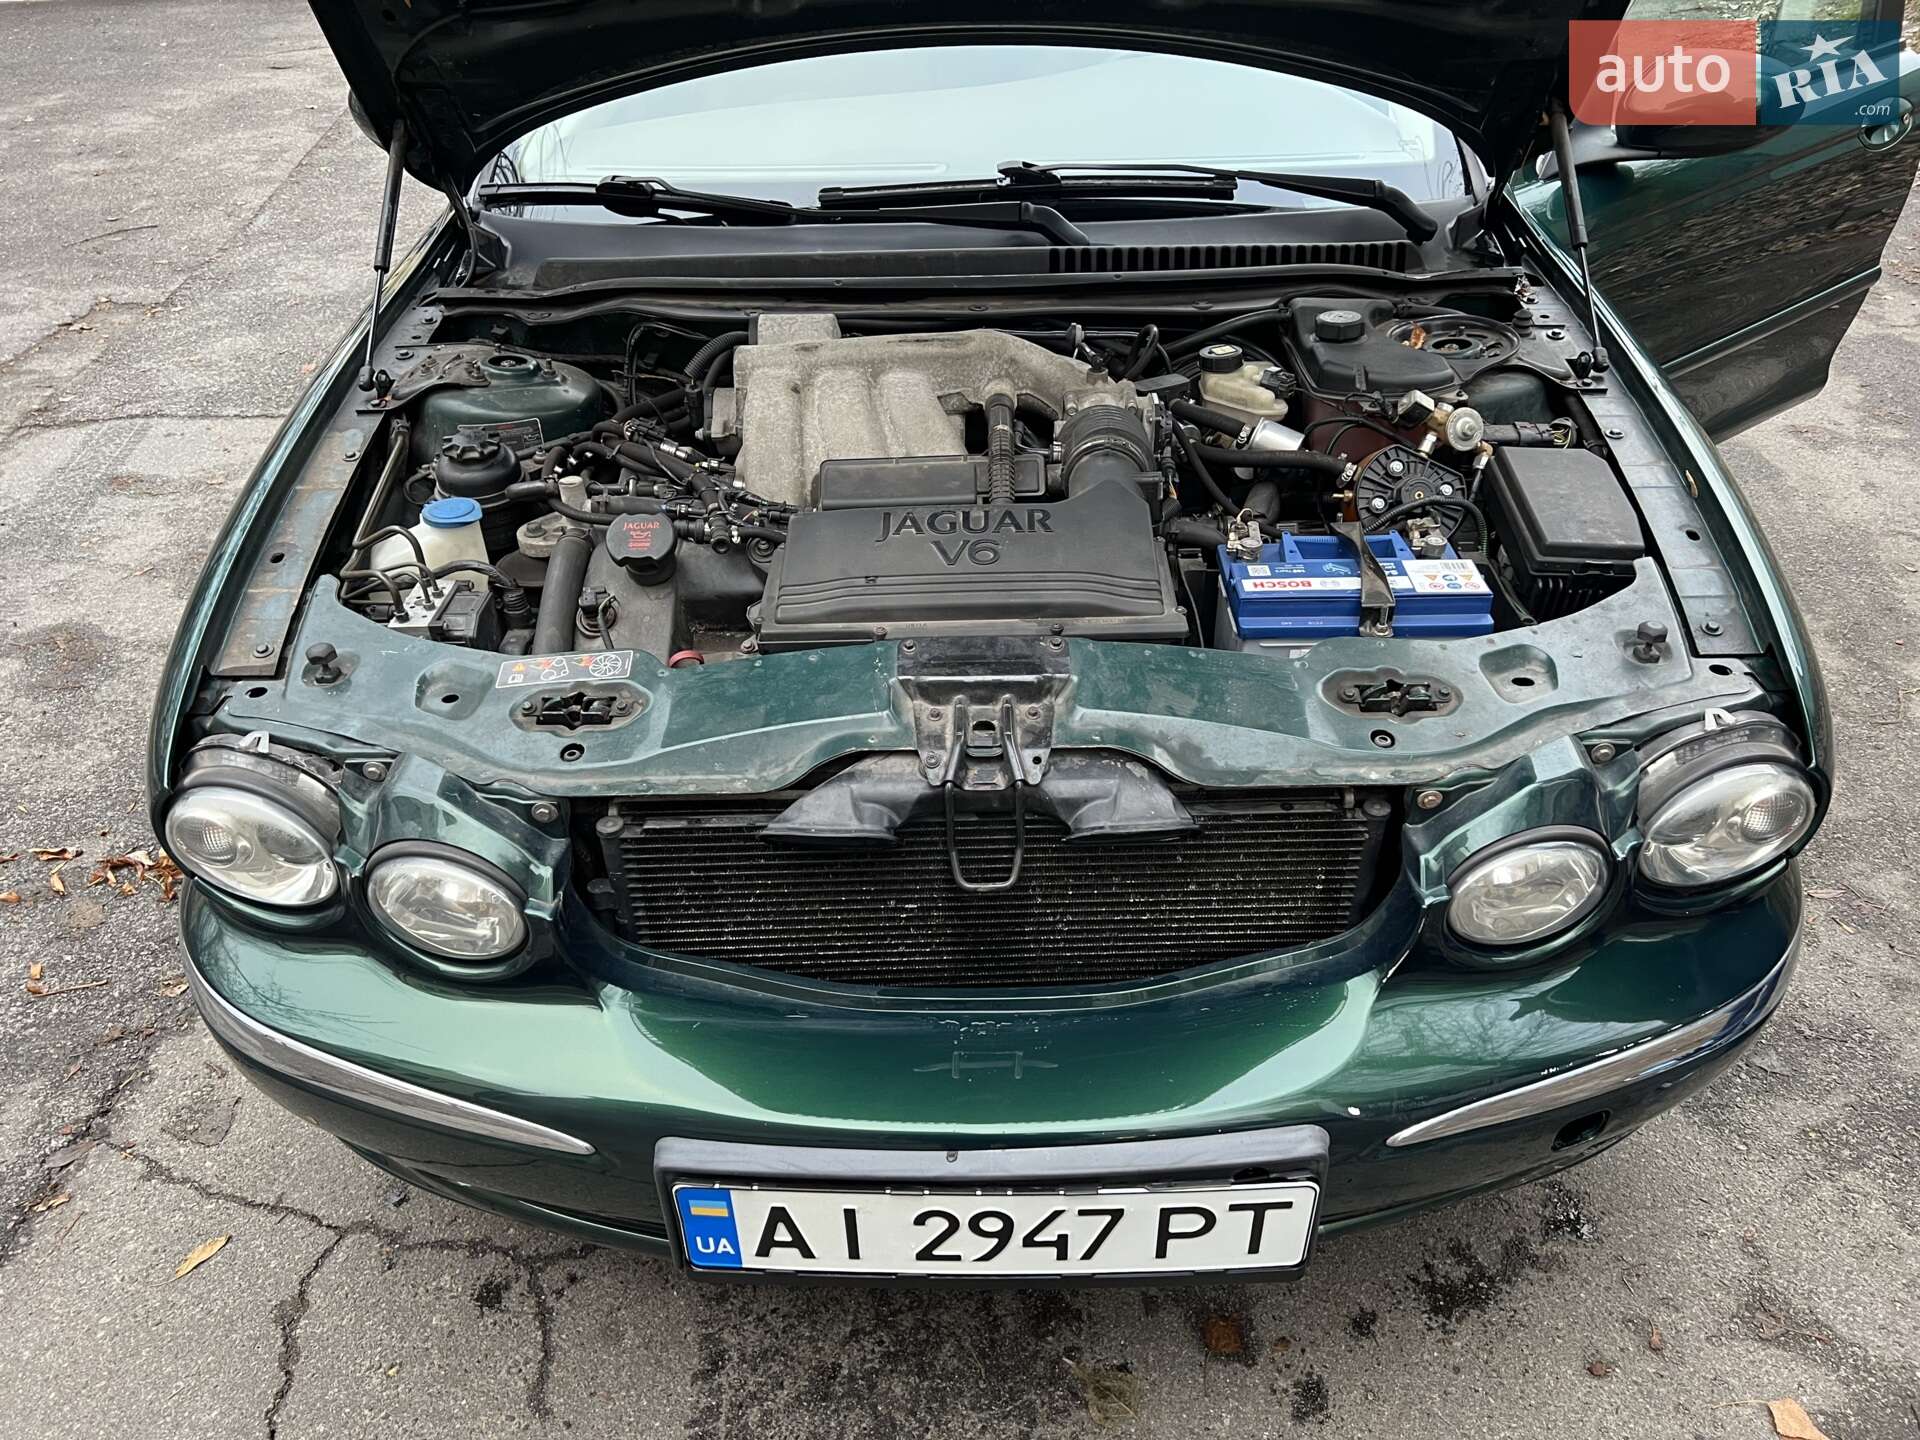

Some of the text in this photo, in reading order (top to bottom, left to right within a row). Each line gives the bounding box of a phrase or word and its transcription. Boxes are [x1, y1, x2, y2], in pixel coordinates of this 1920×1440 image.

[623, 521, 660, 530] JAGUAR
[875, 508, 1055, 542] JAGUAR
[931, 539, 1000, 566] V6
[1253, 580, 1312, 588] BOSCH
[755, 1201, 1294, 1262] AI 2947 PT
[696, 1236, 736, 1255] UA
